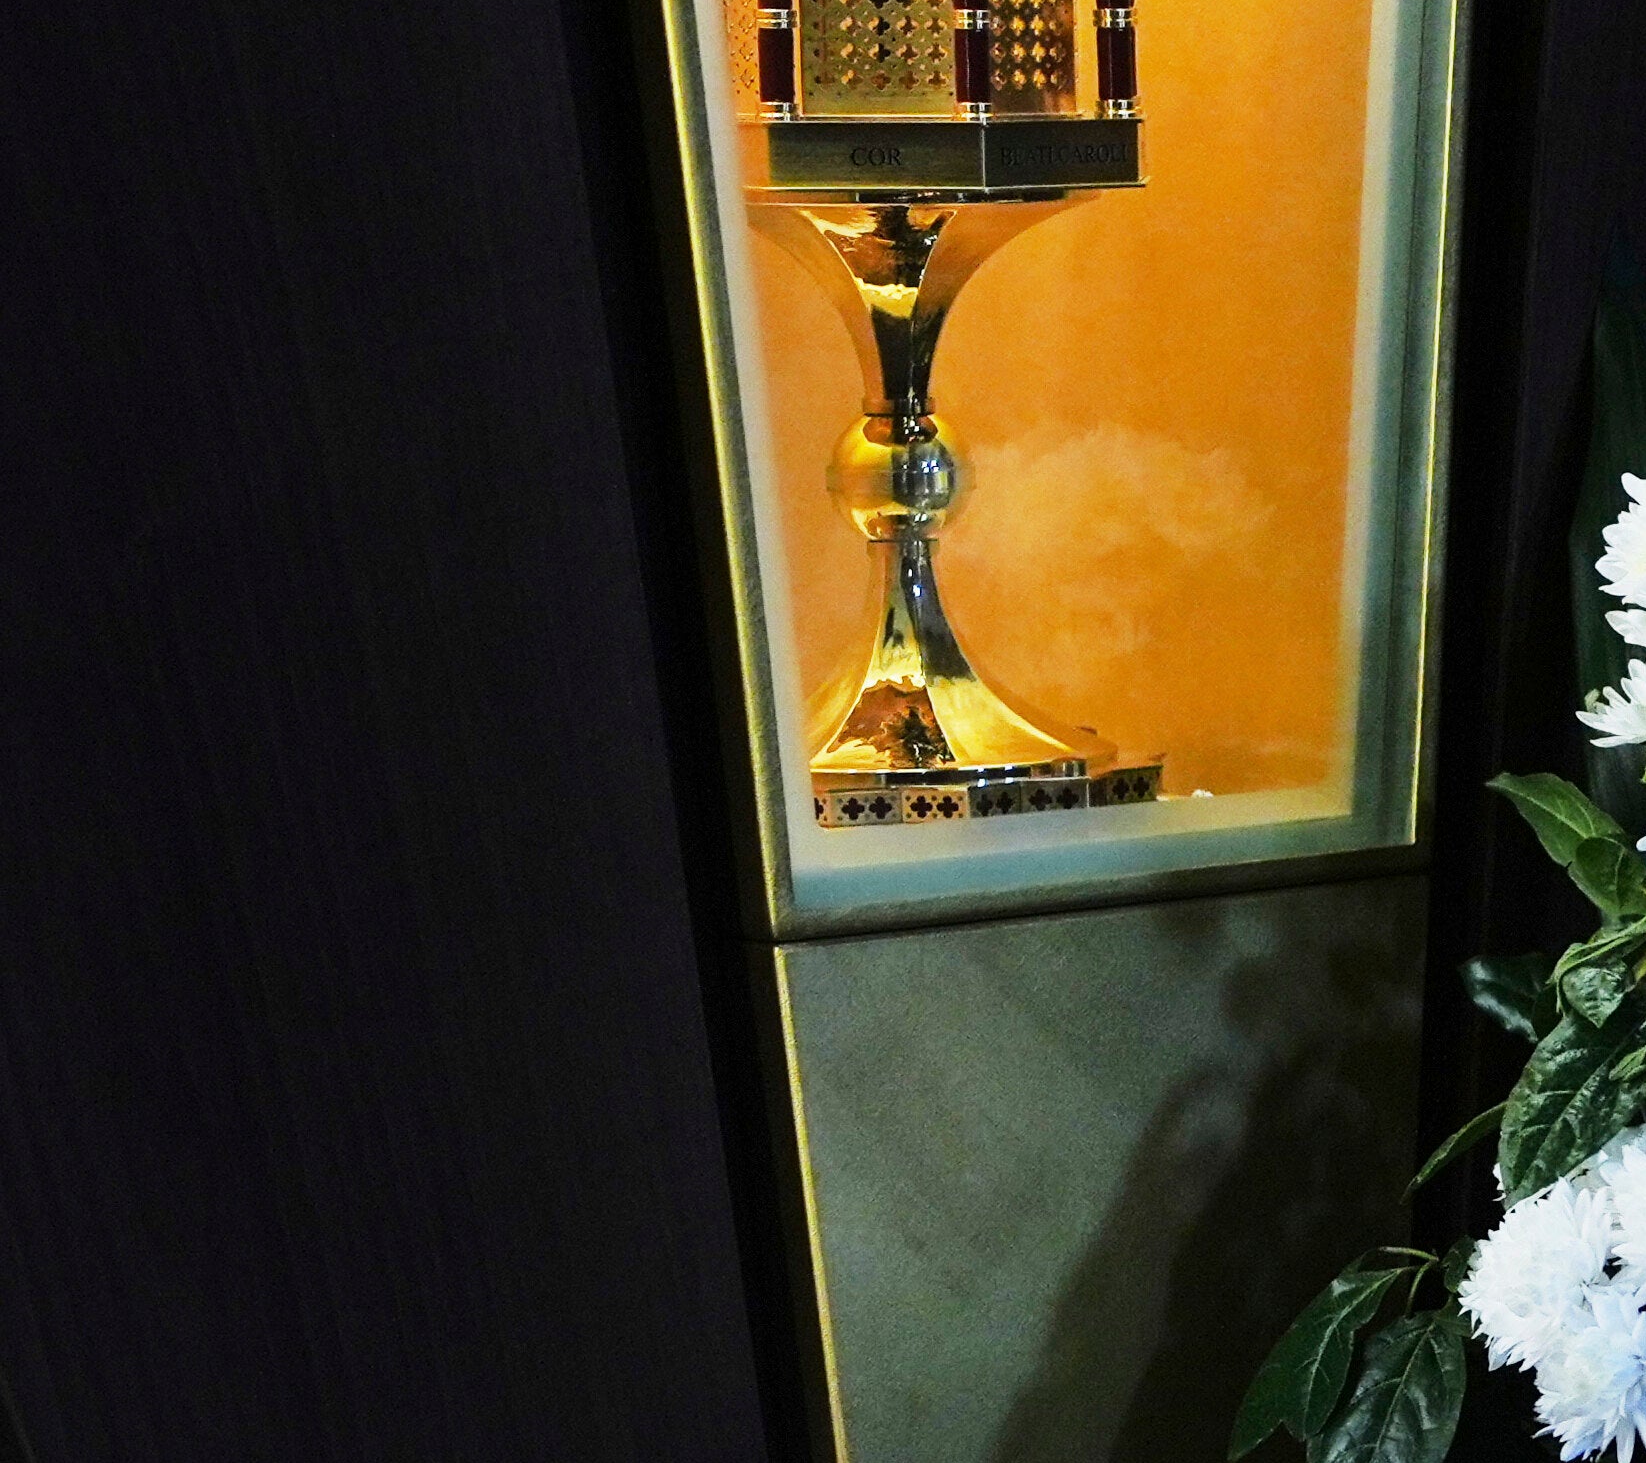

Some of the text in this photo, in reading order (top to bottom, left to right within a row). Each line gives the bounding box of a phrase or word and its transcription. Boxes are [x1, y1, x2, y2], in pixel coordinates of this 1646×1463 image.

[850, 143, 1128, 166] COR BEATI CAROLI
